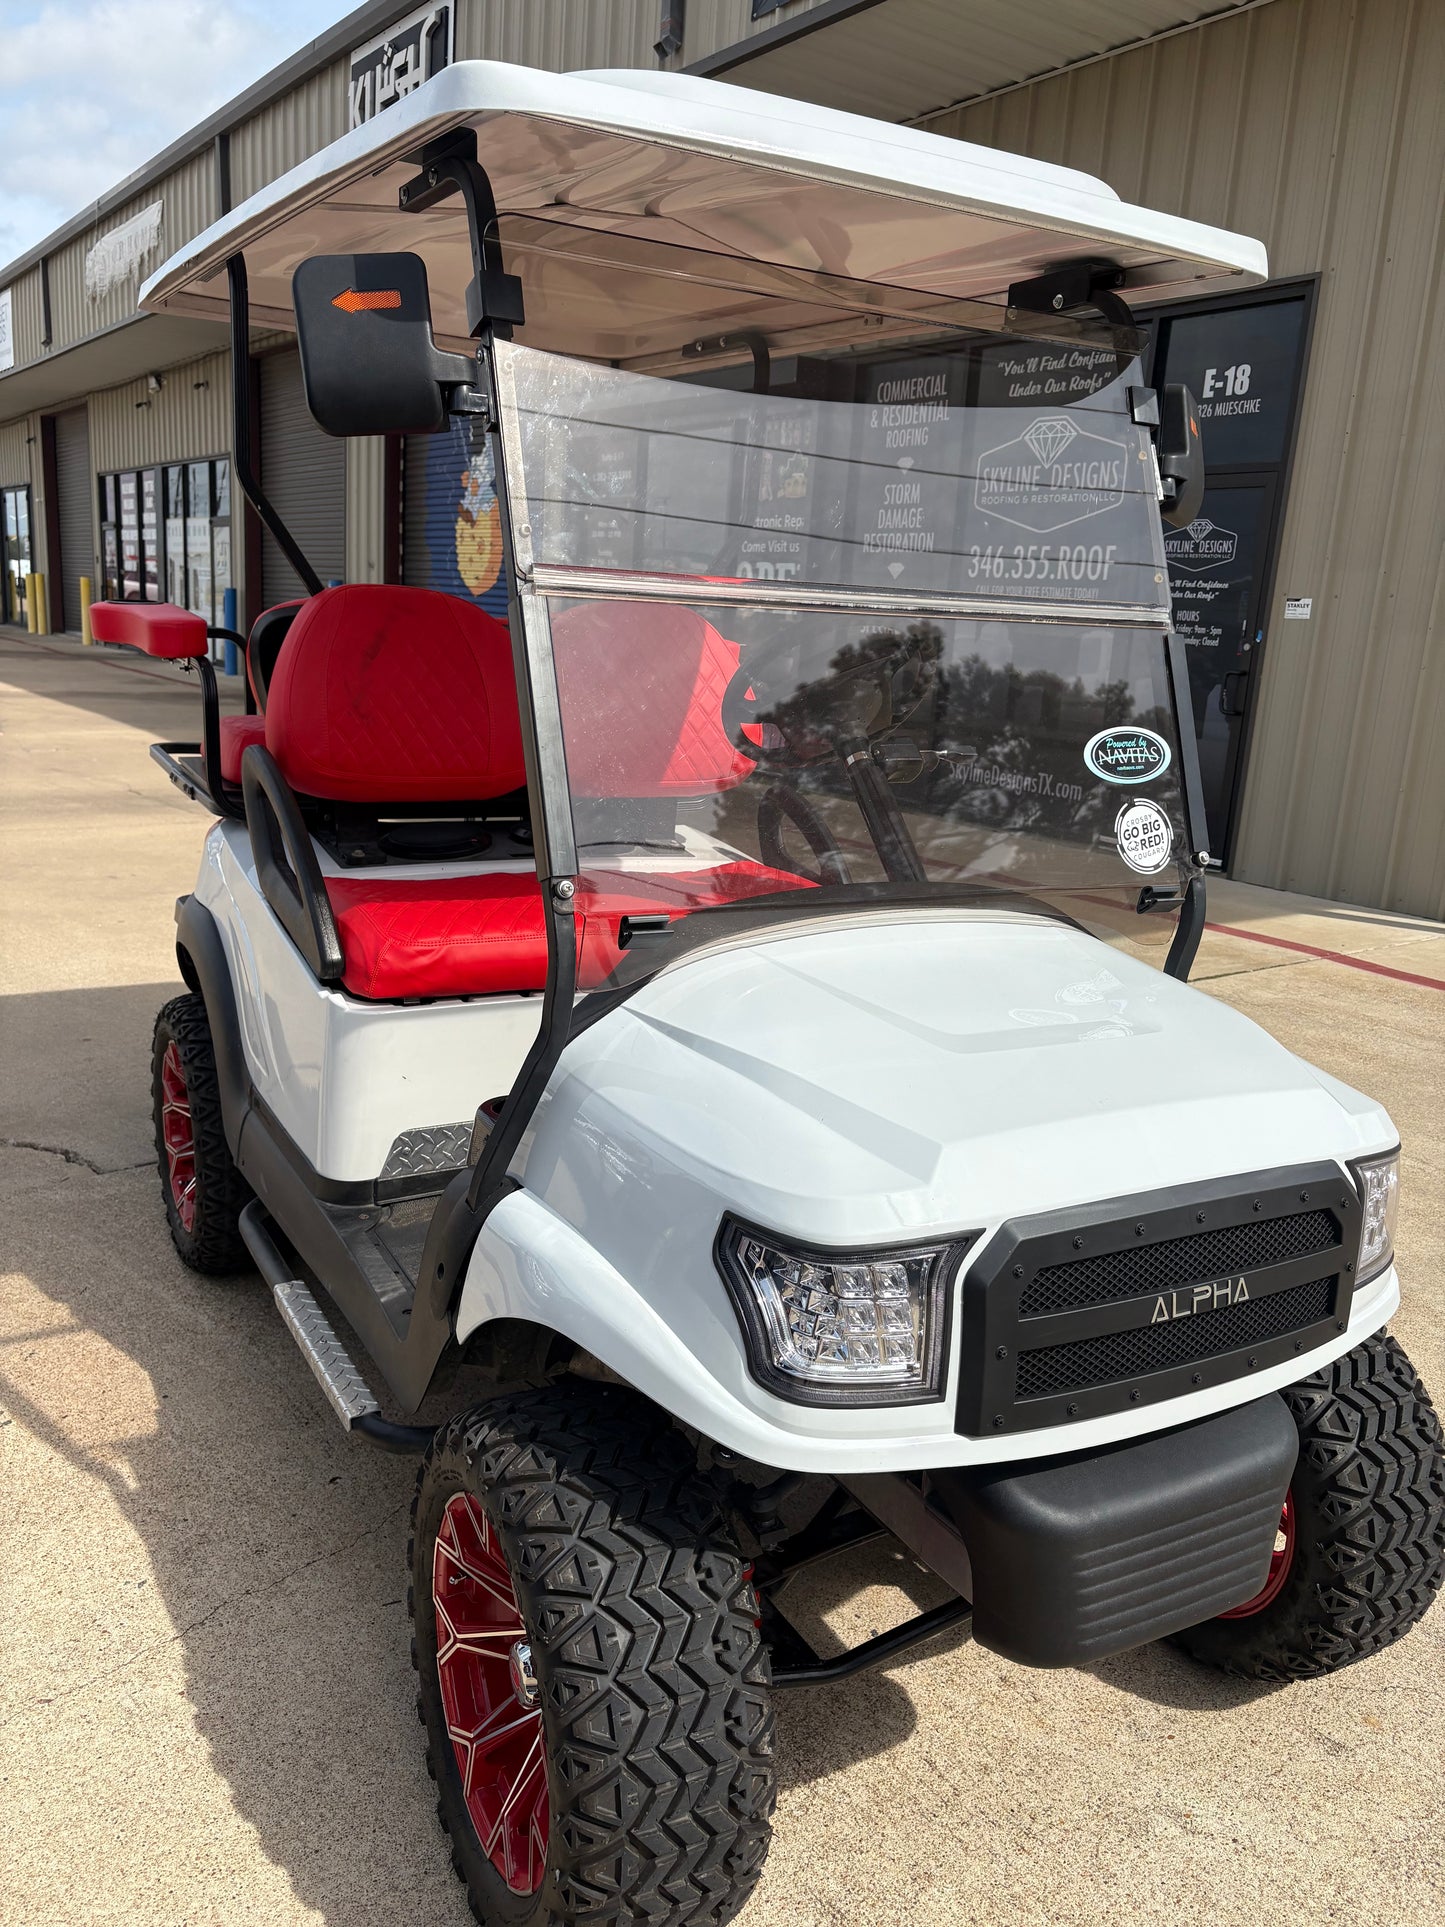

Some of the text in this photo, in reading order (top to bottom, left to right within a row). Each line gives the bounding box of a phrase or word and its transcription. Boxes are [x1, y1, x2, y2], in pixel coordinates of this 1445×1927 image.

[1040, 354, 1067, 372] Find
[1069, 352, 1116, 370] Confiden
[877, 374, 948, 403] COMMERCIAL
[1009, 383, 1042, 398] Under
[1045, 379, 1067, 394] Our
[1202, 364, 1252, 398] E-18
[870, 400, 950, 428] & RESIDENTIAL
[1214, 399, 1261, 417] MUESCHKE
[886, 427, 929, 448] ROOFING
[981, 461, 1120, 493] SKYLINE DESIGNS
[884, 483, 921, 505] STORM
[982, 492, 1116, 505] ROOFING & RESTORATION LLC
[877, 508, 922, 529] DAMAGE
[741, 539, 800, 553] Come Visit us
[863, 532, 934, 552] RESTORATION
[1164, 540, 1233, 553] SKYLINE DESIGNS
[968, 545, 1117, 581] 346.355.ROOF
[1024, 586, 1040, 597] FREE
[1041, 587, 1072, 599] ESTIMATE
[1182, 580, 1197, 588] Find
[1197, 580, 1229, 590] Confidence
[1176, 610, 1200, 622] HOURS
[1210, 625, 1223, 636] 5pm
[1202, 636, 1219, 647] Closed
[1106, 736, 1147, 750] Powered by
[1098, 746, 1160, 765] NAVITAS
[1123, 819, 1161, 841] GO BIG
[1126, 813, 1152, 828] CROSBY
[1140, 832, 1165, 851] RED!
[1133, 845, 1165, 862] COUGARS
[1151, 1277, 1250, 1324] ALPHA
